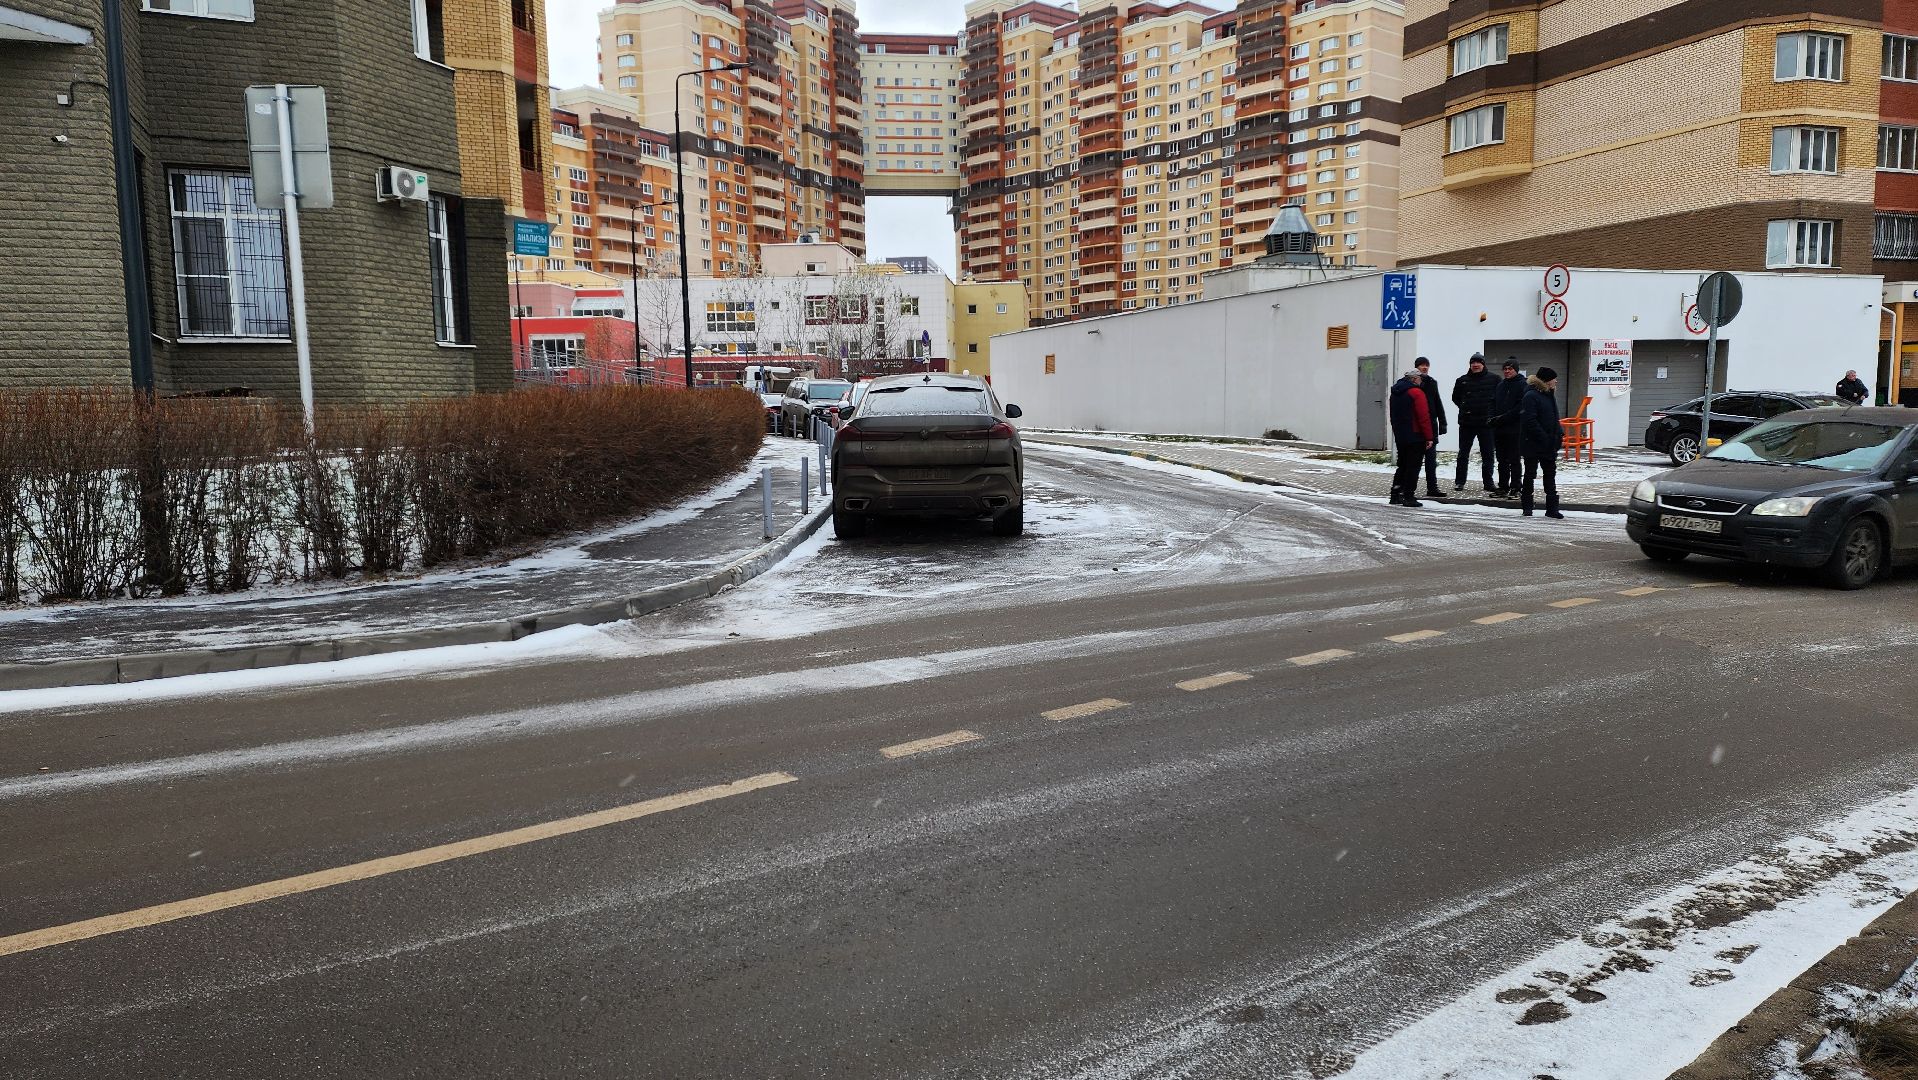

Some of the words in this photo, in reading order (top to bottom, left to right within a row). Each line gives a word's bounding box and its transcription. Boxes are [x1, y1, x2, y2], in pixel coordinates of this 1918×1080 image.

[517, 234, 547, 243] АНАЛИЗЫ
[1554, 274, 1561, 288] 5
[1549, 305, 1562, 317] 2,1
